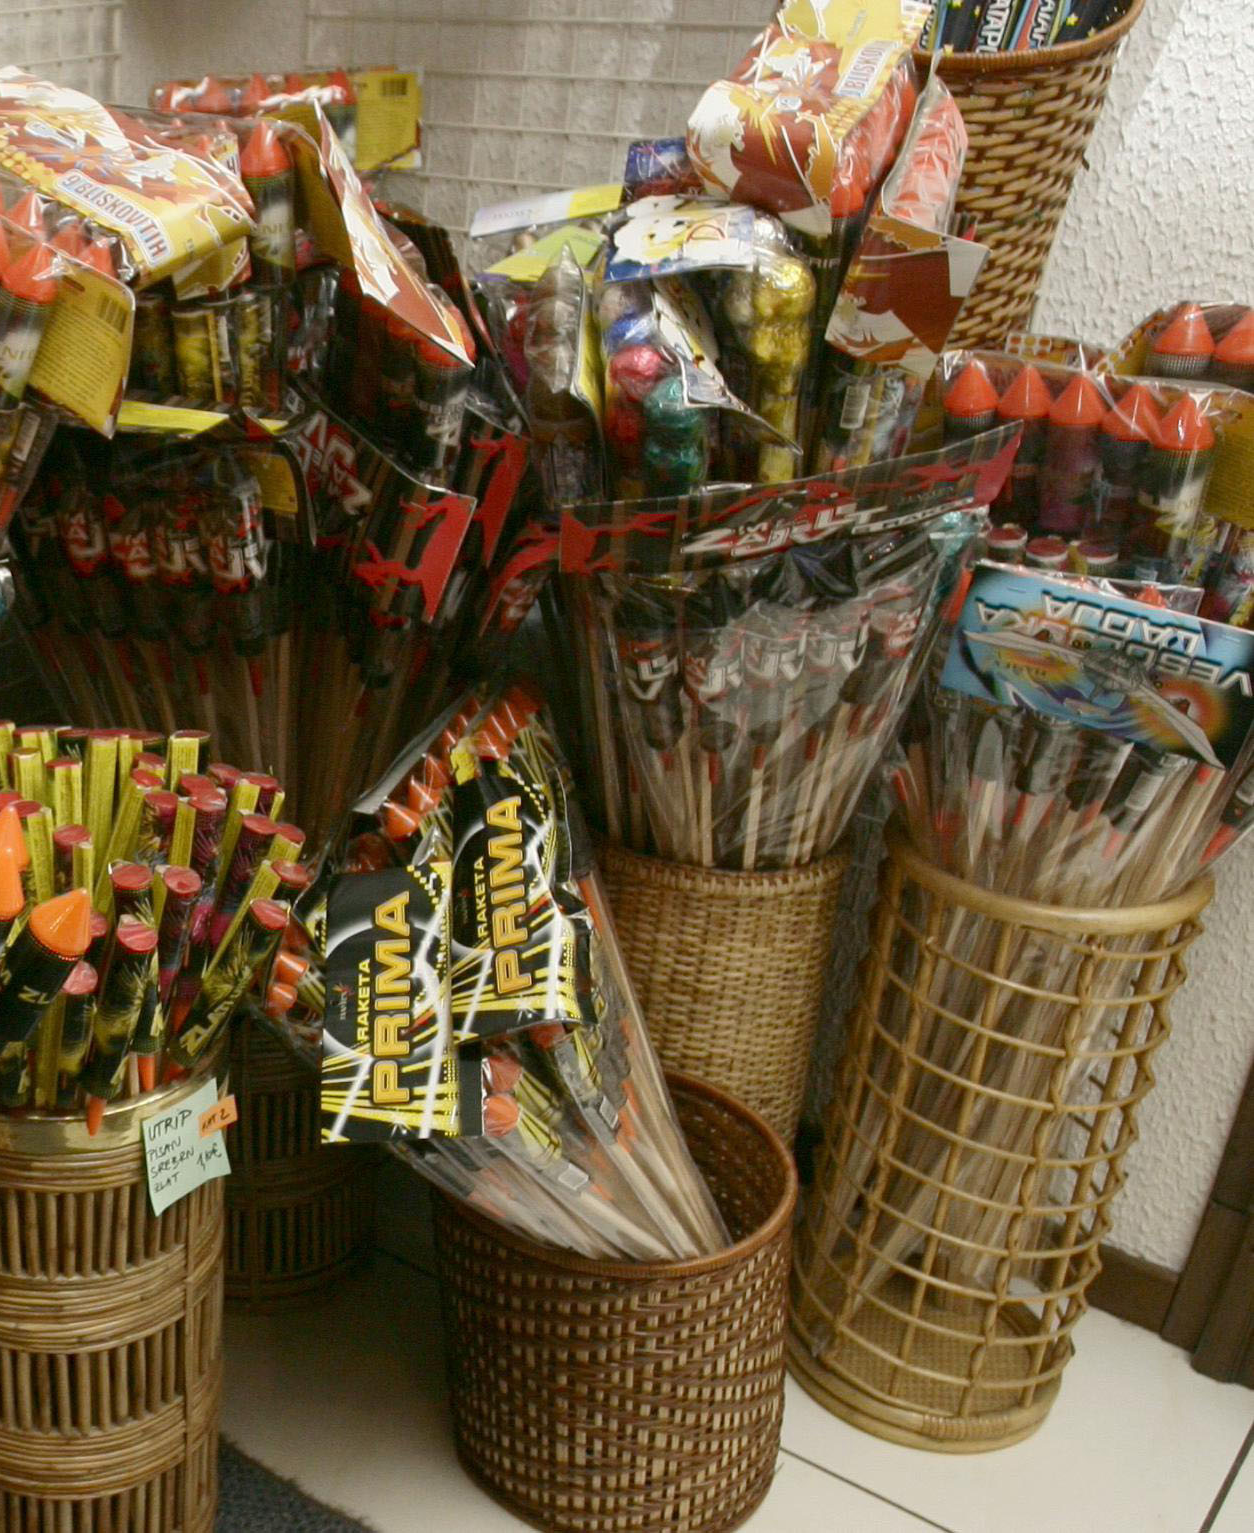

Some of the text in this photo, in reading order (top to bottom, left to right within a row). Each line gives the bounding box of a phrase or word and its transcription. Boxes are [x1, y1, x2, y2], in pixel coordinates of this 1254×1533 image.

[1041, 590, 1205, 659] LADJA
[474, 855, 489, 941] RAKETA
[486, 795, 533, 995] PRIMA
[357, 958, 371, 1043] RAKETA
[373, 889, 411, 1105] PRIMA
[147, 1108, 193, 1142] UTRIP
[147, 1135, 182, 1163] PISAN
[149, 1146, 195, 1179] SREBRN
